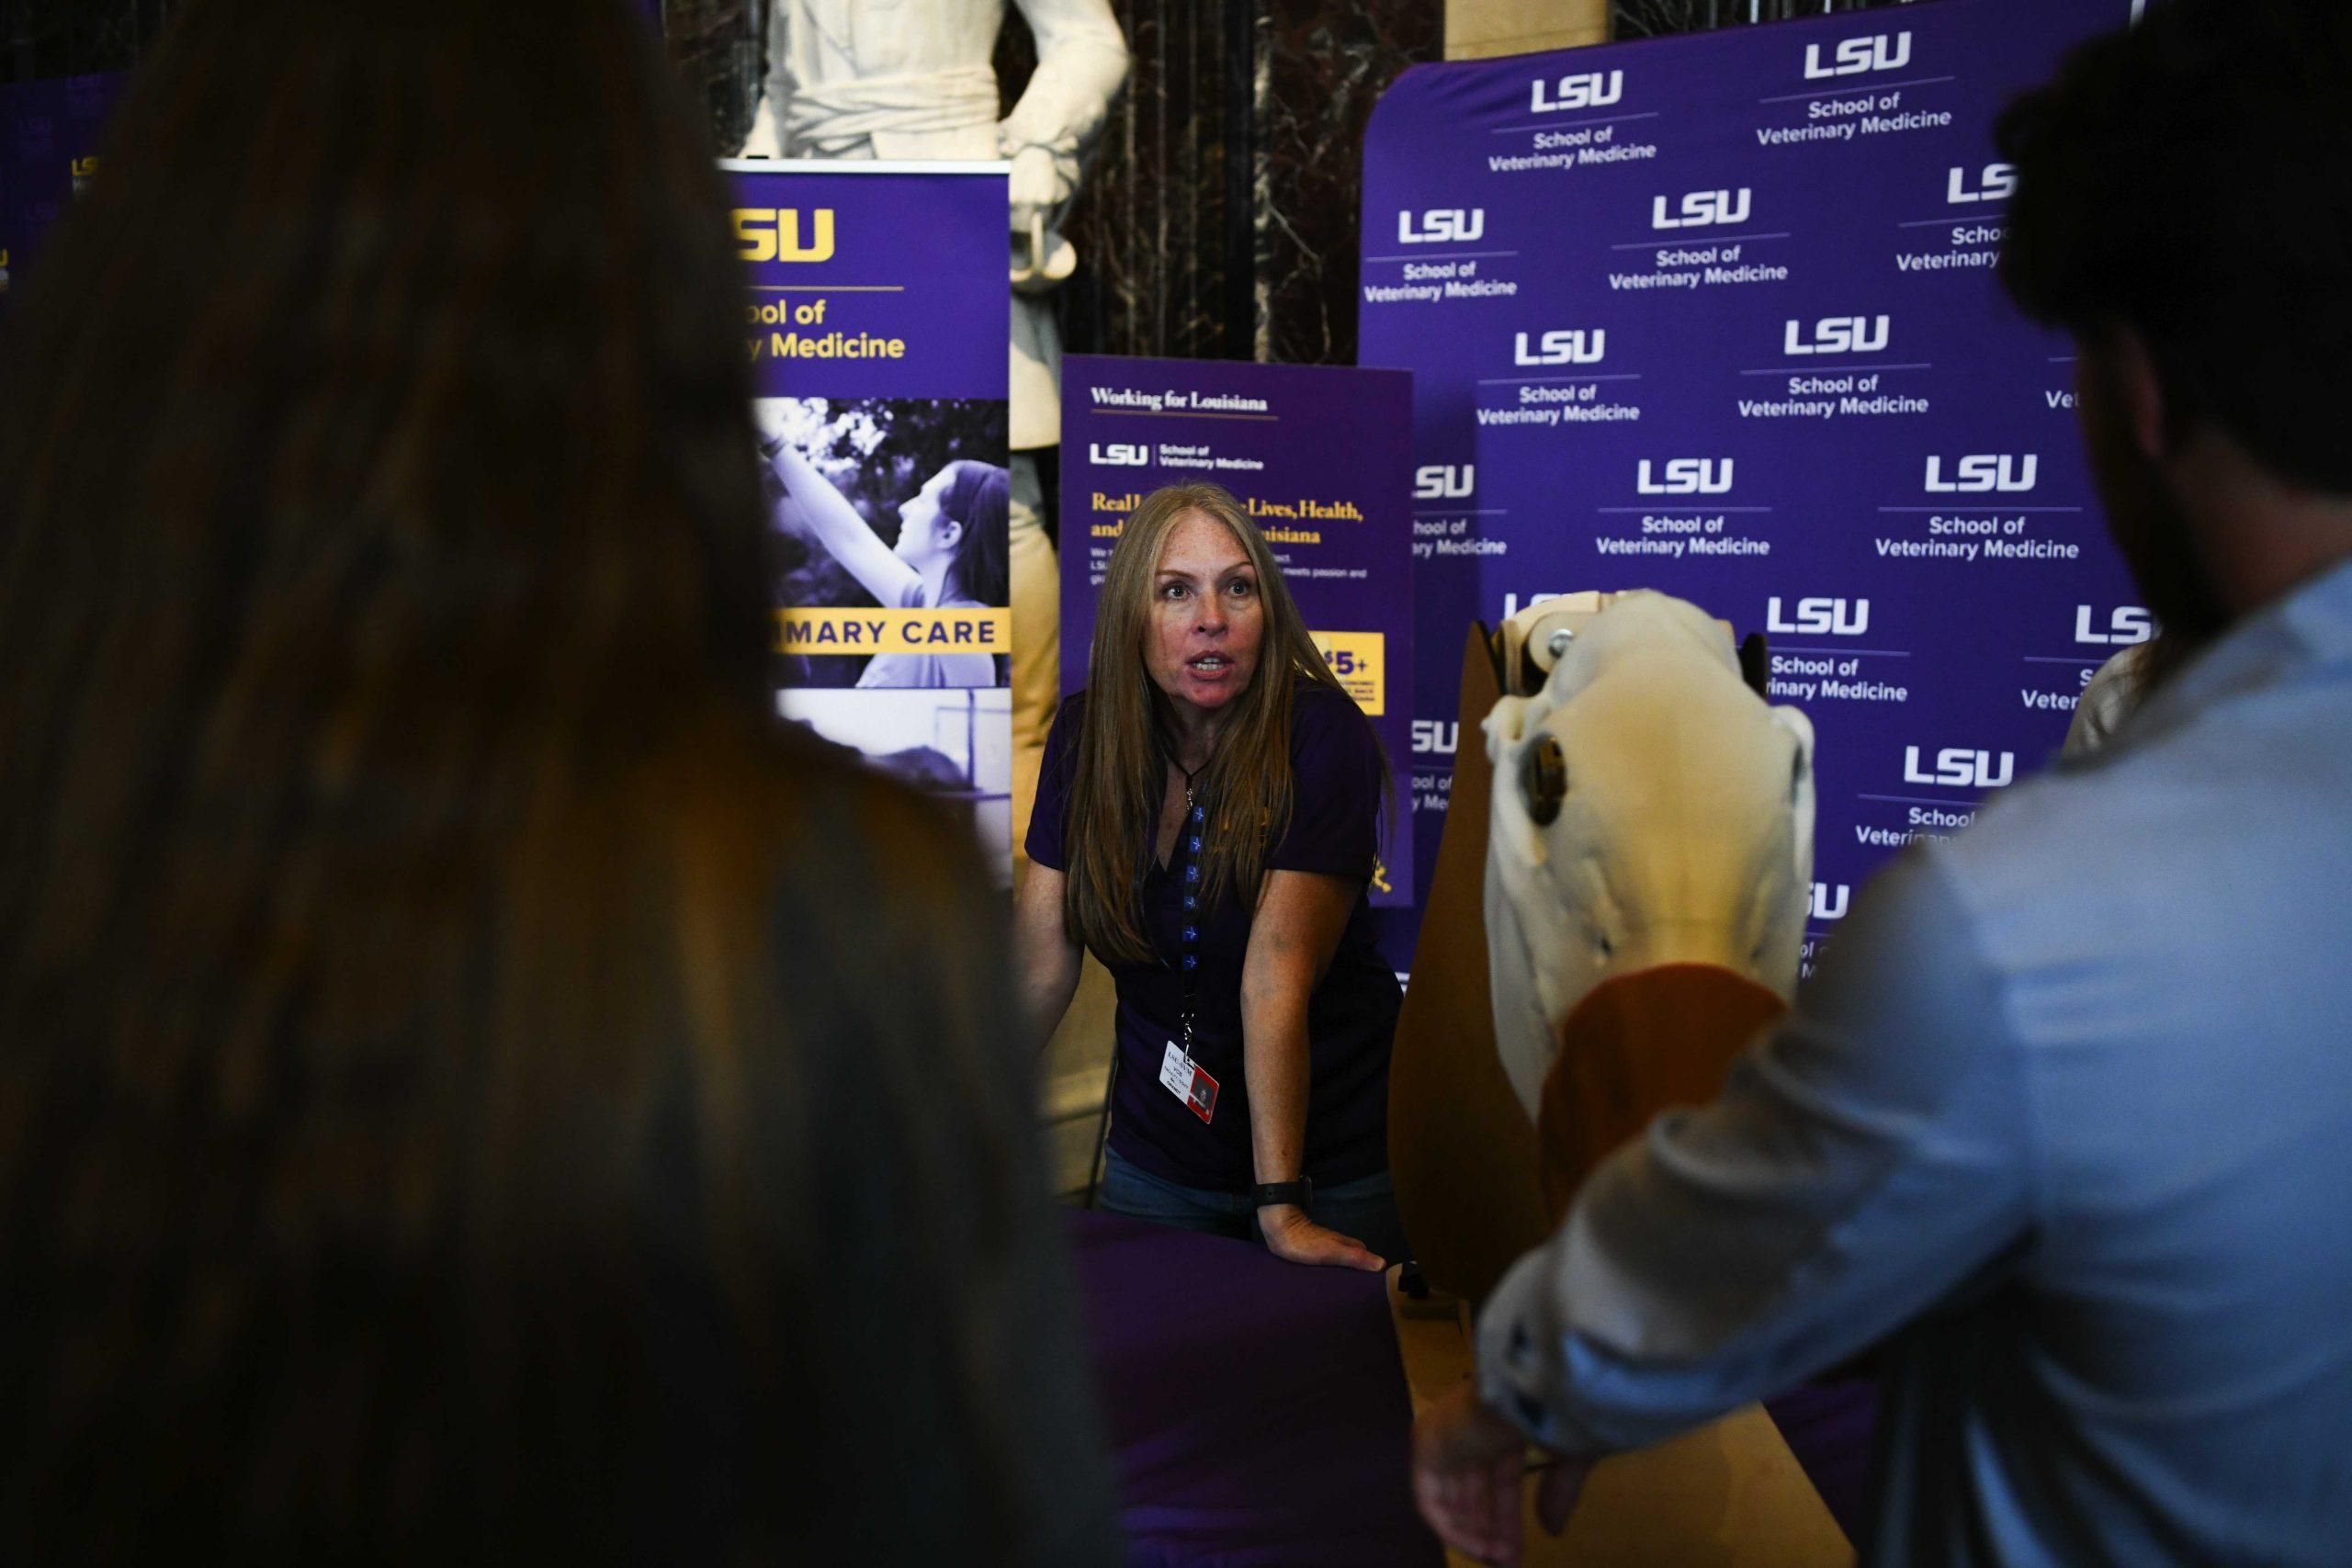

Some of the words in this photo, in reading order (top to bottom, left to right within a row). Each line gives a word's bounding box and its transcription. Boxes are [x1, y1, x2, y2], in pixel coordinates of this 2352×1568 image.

[1804, 31, 1912, 79] LSU
[1531, 70, 1623, 113] LSU
[1808, 95, 1874, 119] School
[1879, 91, 1901, 110] of
[1533, 129, 1590, 149] School
[1593, 125, 1613, 142] of
[1757, 122, 1856, 145] Veterinary
[1860, 108, 1952, 135] Medicine
[72, 157, 98, 176] LS
[1488, 152, 1575, 172] Veterinary
[1577, 142, 1657, 164] Medicine
[1947, 164, 2019, 204] LS
[1652, 187, 1751, 230] LSU
[731, 208, 834, 263] SU
[1397, 208, 1485, 243] LSU
[1656, 247, 1717, 267] School
[1721, 244, 1742, 263] of
[1403, 262, 1456, 281] School
[1458, 260, 1476, 277] of
[1609, 269, 1700, 290] Veterinary
[1704, 264, 1788, 284] Medicine
[1364, 284, 1442, 302] Veterinary
[1444, 279, 1517, 298] Medicine
[795, 299, 826, 325] of
[771, 332, 905, 358] Medicine
[1514, 328, 1605, 367] LSU
[1784, 314, 1890, 355] LSU
[1520, 384, 1575, 403] School
[1577, 384, 1597, 401] of
[1788, 376, 1853, 395] School
[1858, 374, 1879, 392] of
[1091, 387, 1162, 411] Working
[1165, 389, 1188, 408] for
[1191, 390, 1267, 412] Louisiana
[1738, 399, 1836, 419] Veterinary
[1839, 395, 1929, 415] Medicine
[1476, 407, 1560, 427] Veterinary
[1563, 403, 1640, 423] Medicine
[1090, 443, 1148, 466] LSU
[1159, 444, 1196, 456] School
[1197, 446, 1210, 457] of
[1159, 456, 1214, 470] Veterinary
[1216, 457, 1264, 470] Medicine
[1412, 464, 1475, 499] SU
[1637, 457, 1734, 494] LSU
[1925, 454, 2038, 492] LSU
[1092, 491, 1131, 512] Real
[1249, 498, 1297, 520] Lives,
[1299, 499, 1364, 523] Health,
[1091, 519, 1124, 537] and
[1413, 519, 1447, 536] hool
[1450, 518, 1467, 536] of
[1641, 514, 1702, 534] School
[1704, 514, 1725, 534] of
[1928, 515, 1998, 535] School
[2003, 516, 2027, 535] of
[1436, 537, 1507, 556] Medicine
[1596, 536, 1685, 558] Veterinary
[1689, 536, 1770, 556] Medicine
[1875, 537, 1978, 561] Veterinary
[1984, 539, 2079, 559] Medicine
[1766, 596, 1870, 636] LSU
[2075, 604, 2155, 645] LS
[786, 621, 886, 643] MARY
[902, 621, 994, 643] CARE
[1771, 655, 1834, 676] School
[1838, 658, 1859, 677] of
[1766, 677, 1816, 702] rinary
[1821, 679, 1908, 703] Medicine
[1411, 720, 1459, 753] SU
[1904, 745, 2015, 787] LSU
